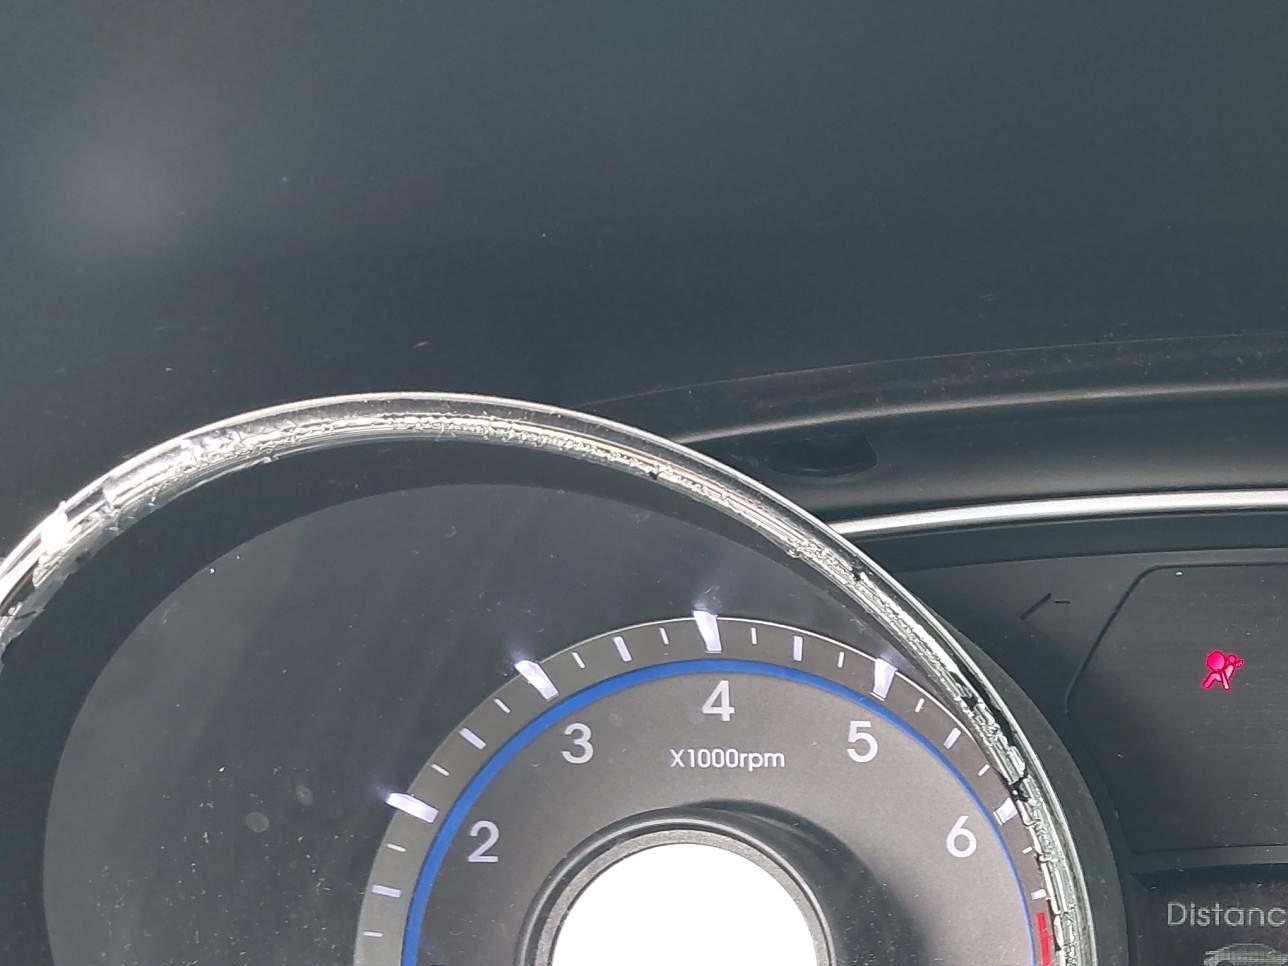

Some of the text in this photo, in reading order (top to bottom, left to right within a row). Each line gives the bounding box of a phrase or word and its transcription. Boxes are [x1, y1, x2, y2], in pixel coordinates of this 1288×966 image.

[702, 680, 735, 722] 4
[561, 723, 594, 764] 3
[669, 748, 785, 770] X1000rpm
[846, 720, 877, 763] 5
[468, 821, 500, 863] 2
[946, 815, 977, 859] 6
